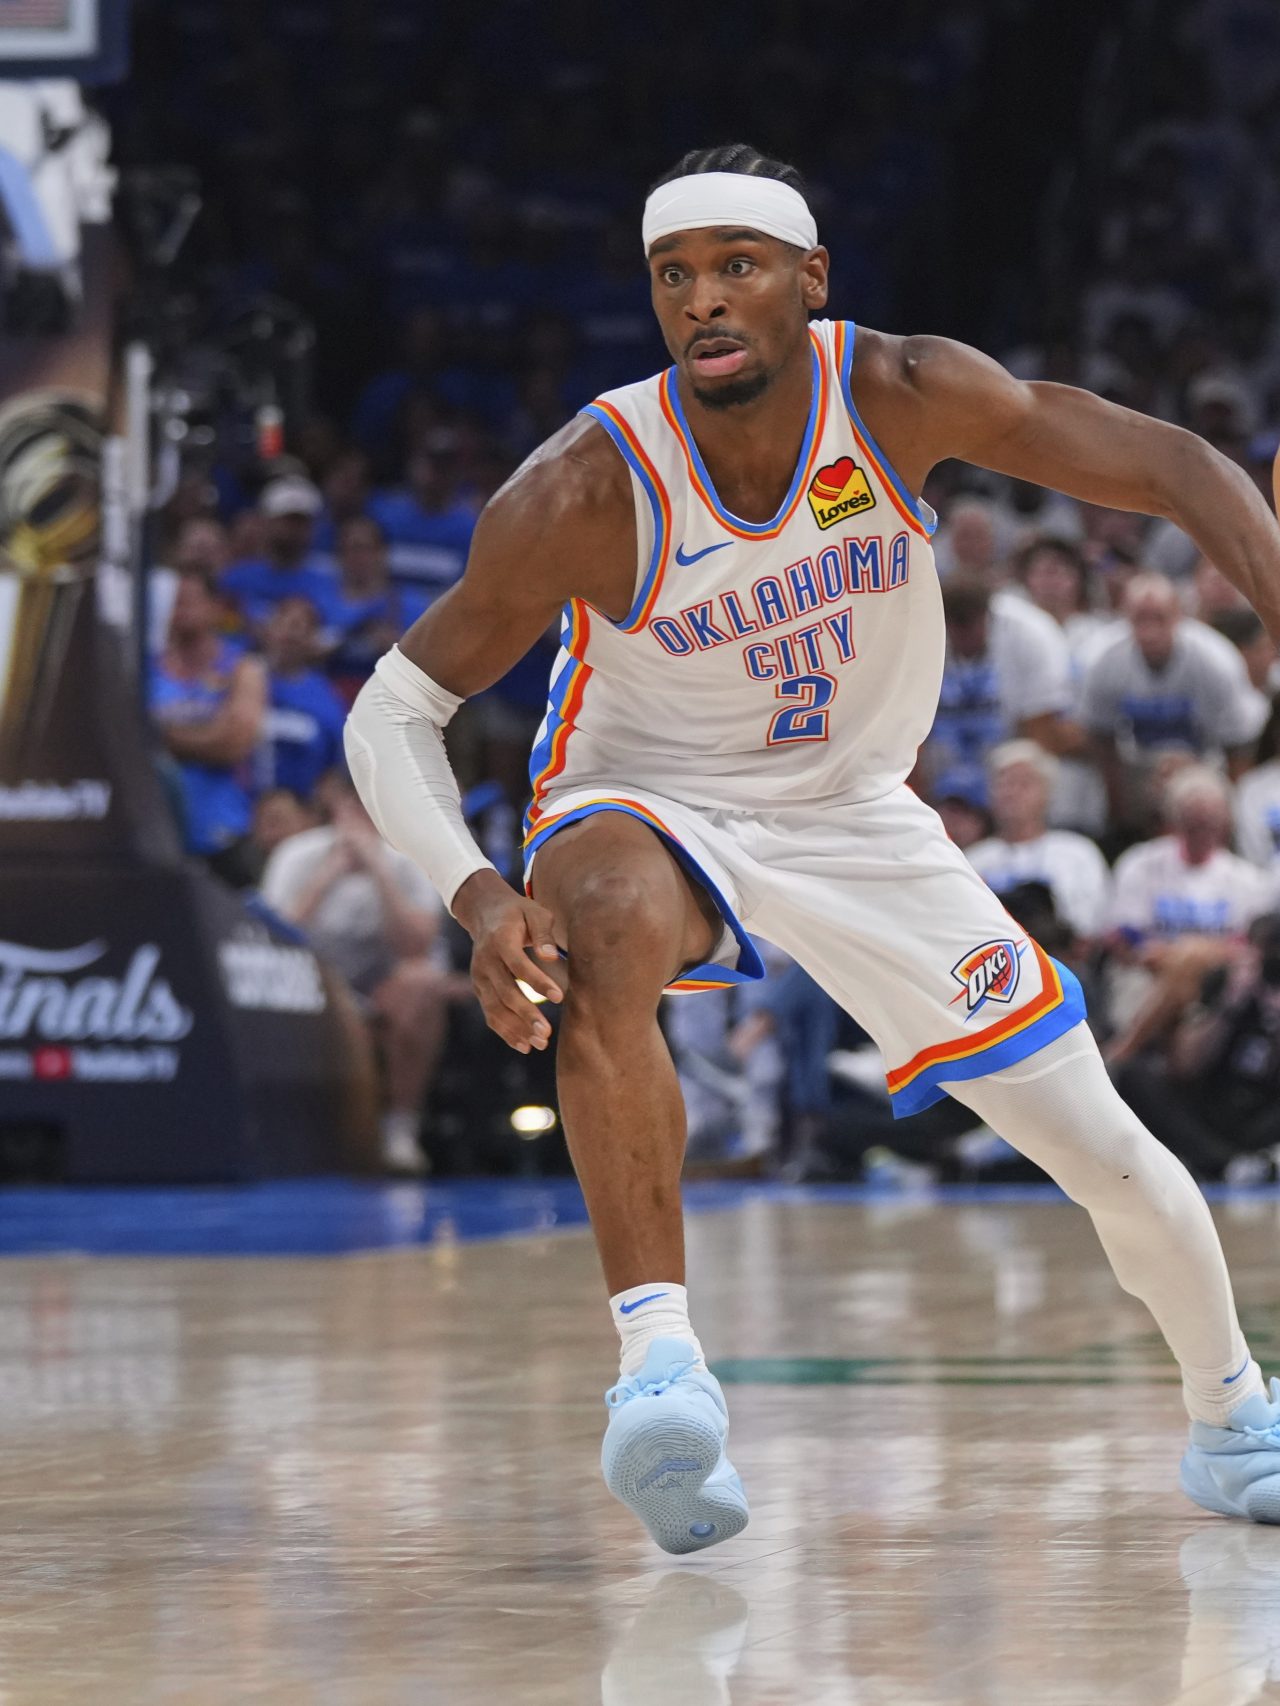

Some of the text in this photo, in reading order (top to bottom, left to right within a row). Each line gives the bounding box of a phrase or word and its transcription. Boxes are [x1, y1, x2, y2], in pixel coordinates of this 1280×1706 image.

[649, 531, 910, 656] OKLAHOMA
[743, 607, 856, 681] CITY
[767, 672, 838, 747] 2
[967, 949, 1008, 1011] OKC
